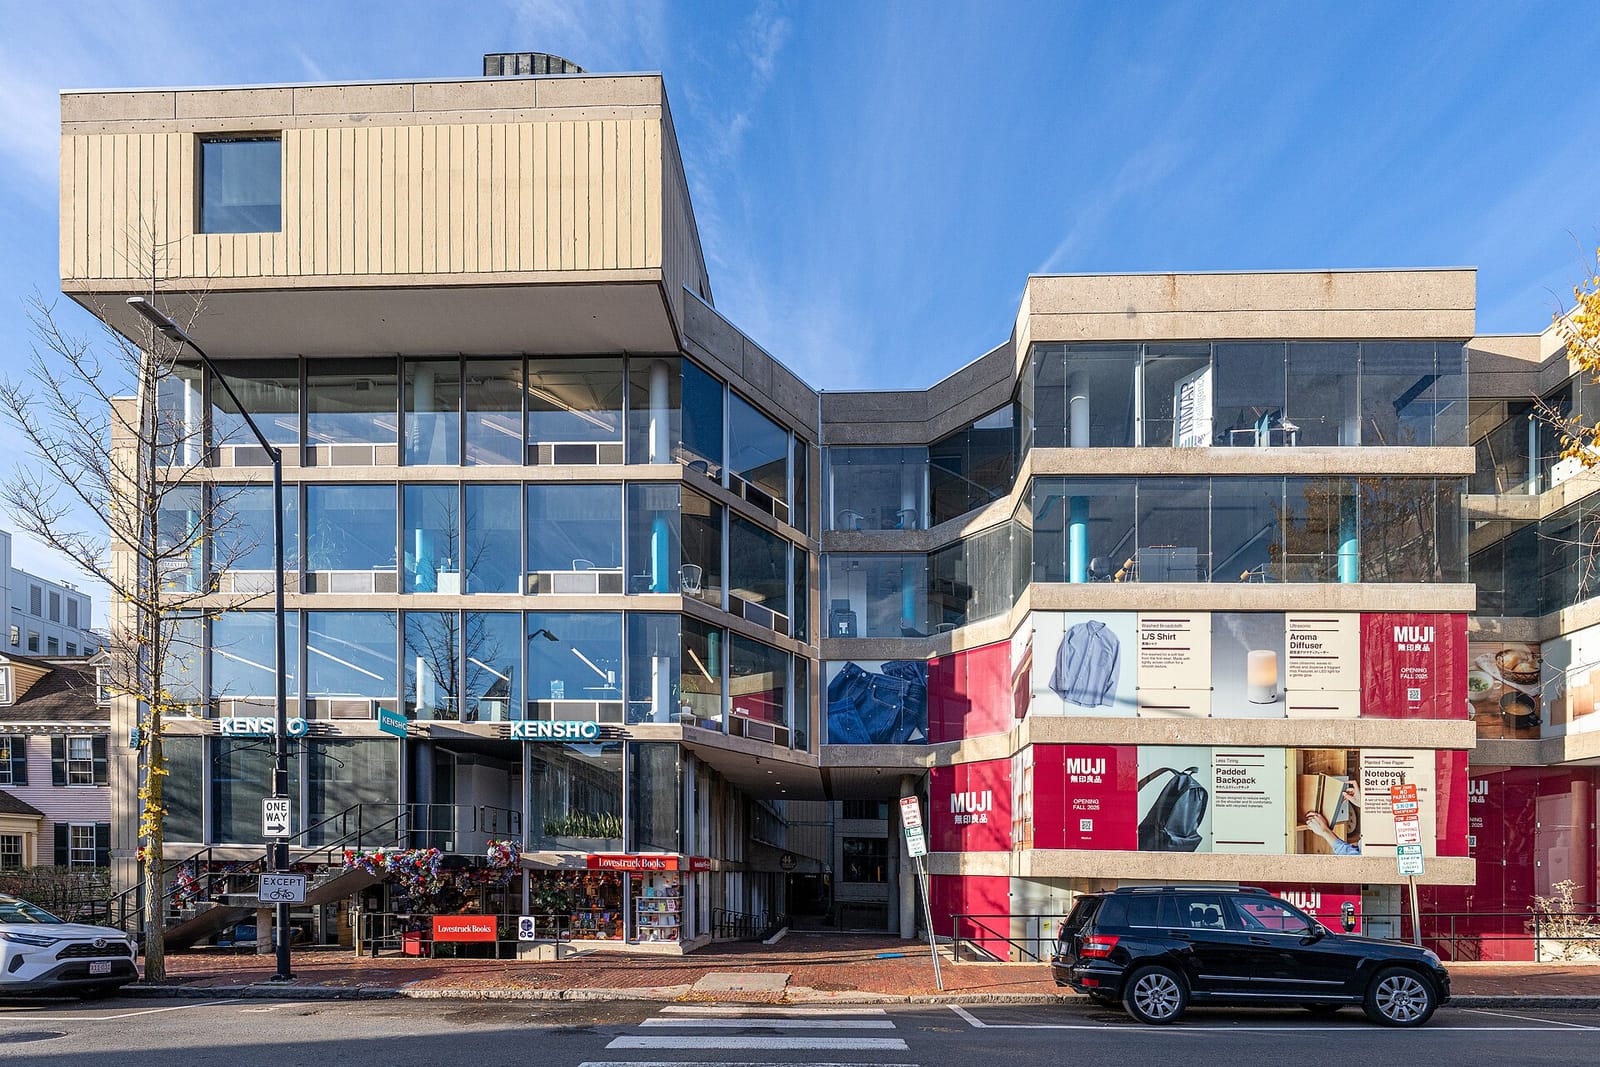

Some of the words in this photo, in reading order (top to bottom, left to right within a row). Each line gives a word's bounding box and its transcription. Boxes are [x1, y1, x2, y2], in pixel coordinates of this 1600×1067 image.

[1394, 626, 1434, 642] MUJI
[220, 718, 304, 735] KENSO
[511, 720, 598, 738] KENSHO
[1067, 758, 1106, 774] MUJI
[1070, 775, 1102, 783] 無印良品
[1216, 776, 1256, 785] Backpack
[1468, 780, 1488, 795] UJI
[266, 802, 287, 811] ONE
[951, 790, 992, 813] MUJI
[266, 813, 287, 822] WAY
[955, 814, 988, 824] 無印良品
[599, 858, 640, 868] Lovestruck
[642, 858, 666, 868] Books
[264, 878, 302, 886] EXCEPT
[1280, 890, 1321, 908] MUJI
